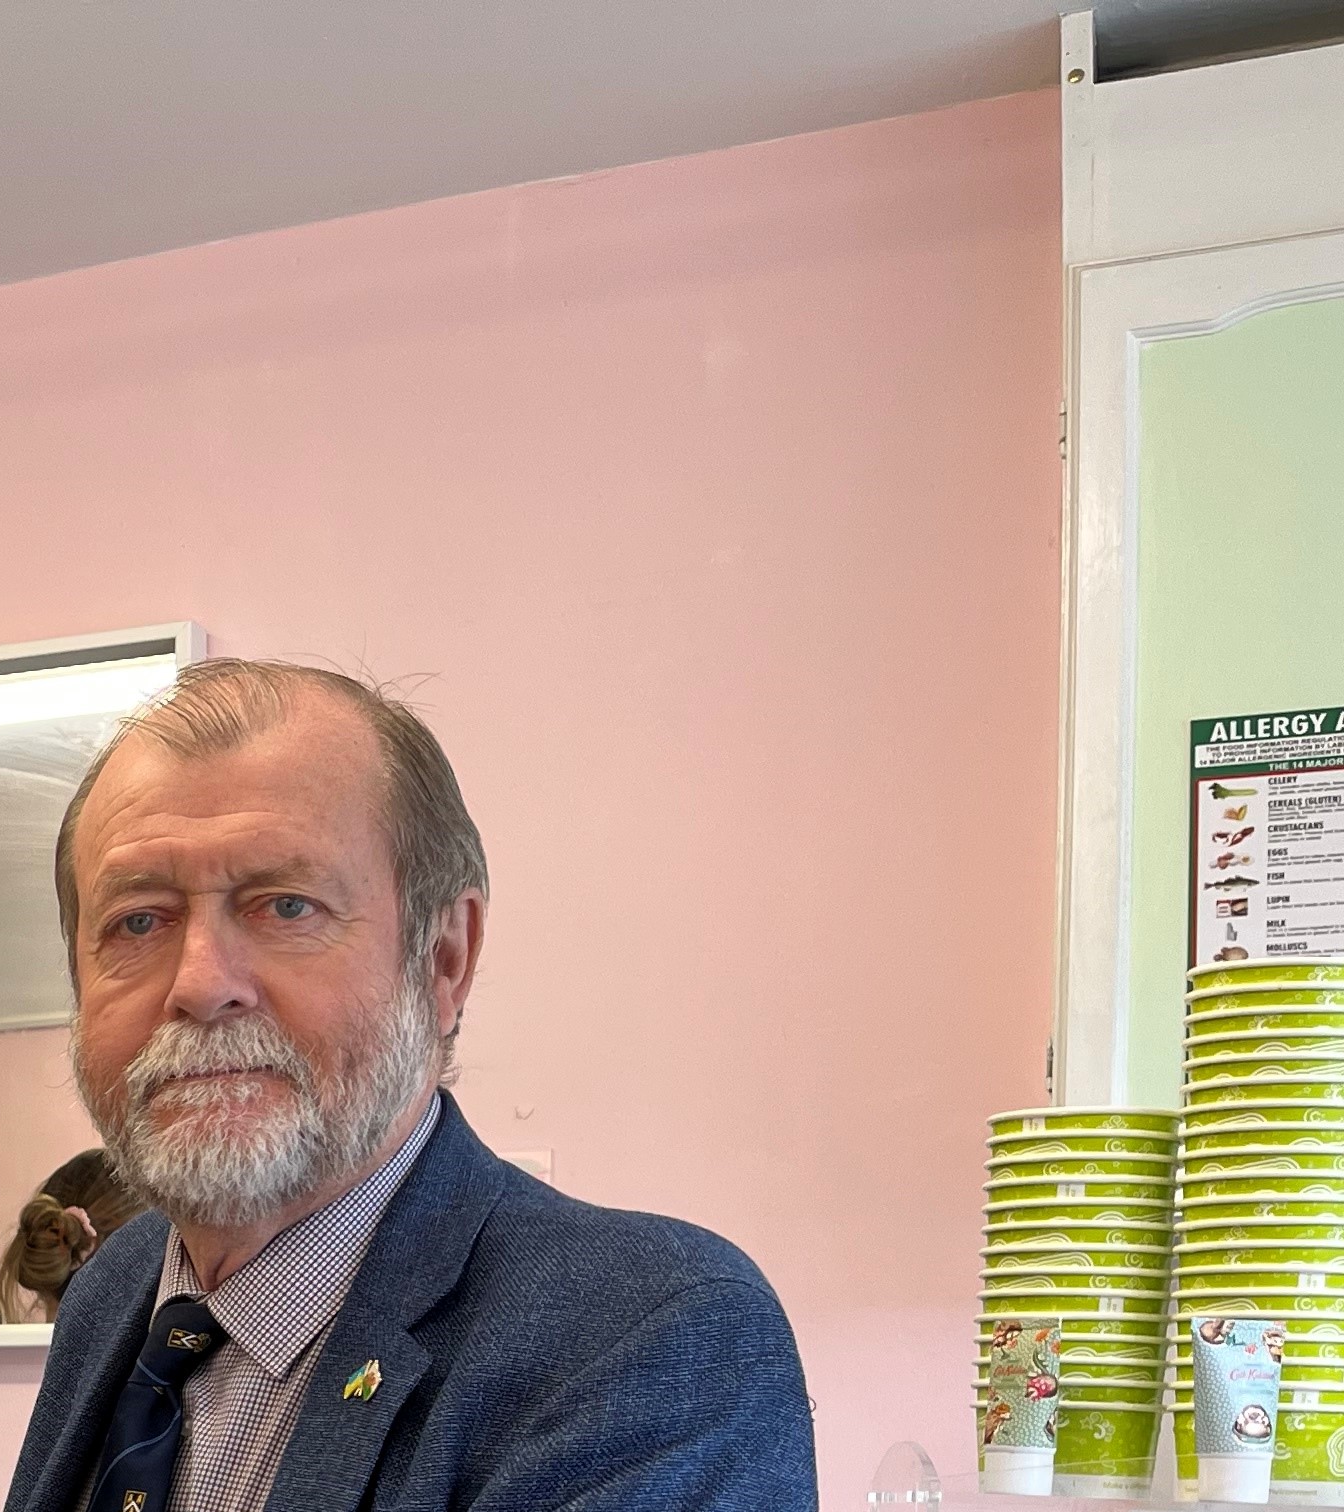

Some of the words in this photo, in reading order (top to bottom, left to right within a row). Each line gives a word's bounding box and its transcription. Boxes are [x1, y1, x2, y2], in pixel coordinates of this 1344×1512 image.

[1210, 713, 1327, 742] ALLERGY
[1269, 762, 1289, 771] THE
[1293, 760, 1303, 769] 14
[1306, 757, 1344, 768] MAJOR
[1268, 776, 1298, 785] CELERY
[1268, 798, 1302, 807] CEREALS
[1268, 821, 1324, 833] CRUSTACEANS
[1268, 848, 1288, 856] EGGS
[1267, 872, 1284, 880] FISH
[1267, 896, 1290, 904] LUPIN
[1267, 919, 1286, 927] MILK
[1267, 942, 1308, 951] MOLLUSCS
